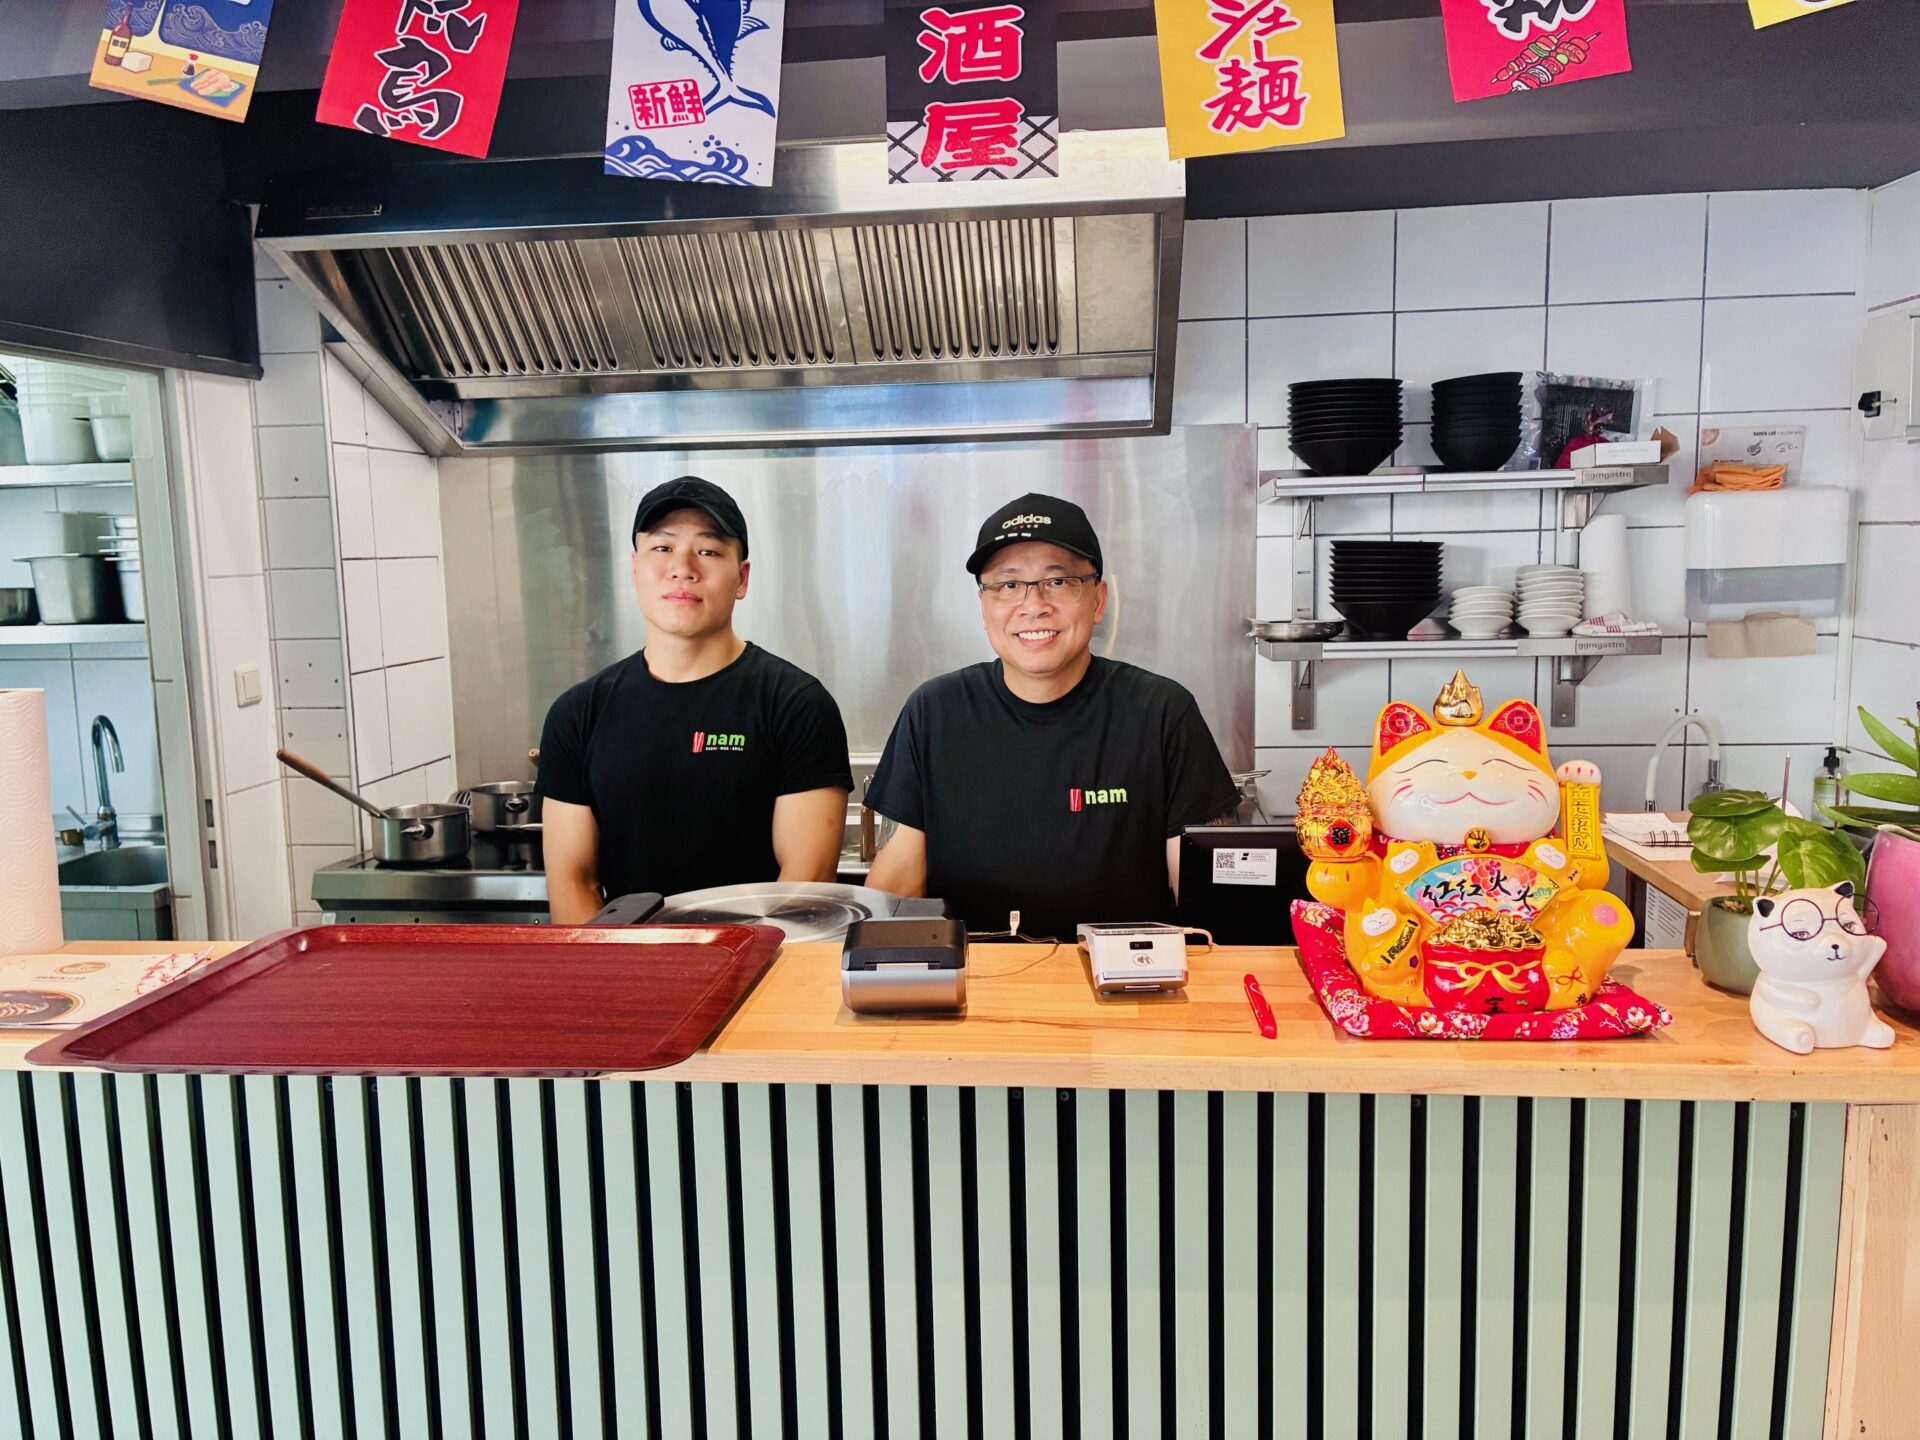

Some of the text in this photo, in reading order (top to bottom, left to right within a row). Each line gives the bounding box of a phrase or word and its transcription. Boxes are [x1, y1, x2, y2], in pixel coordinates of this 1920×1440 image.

[917, 5, 1025, 171] 酒屋
[632, 83, 704, 125] 新鮮
[1584, 470, 1633, 481] ggmgastro
[1002, 514, 1052, 529] adidas
[1578, 641, 1625, 650] ggmgastro
[706, 734, 745, 746] nam
[1085, 788, 1127, 804] nam
